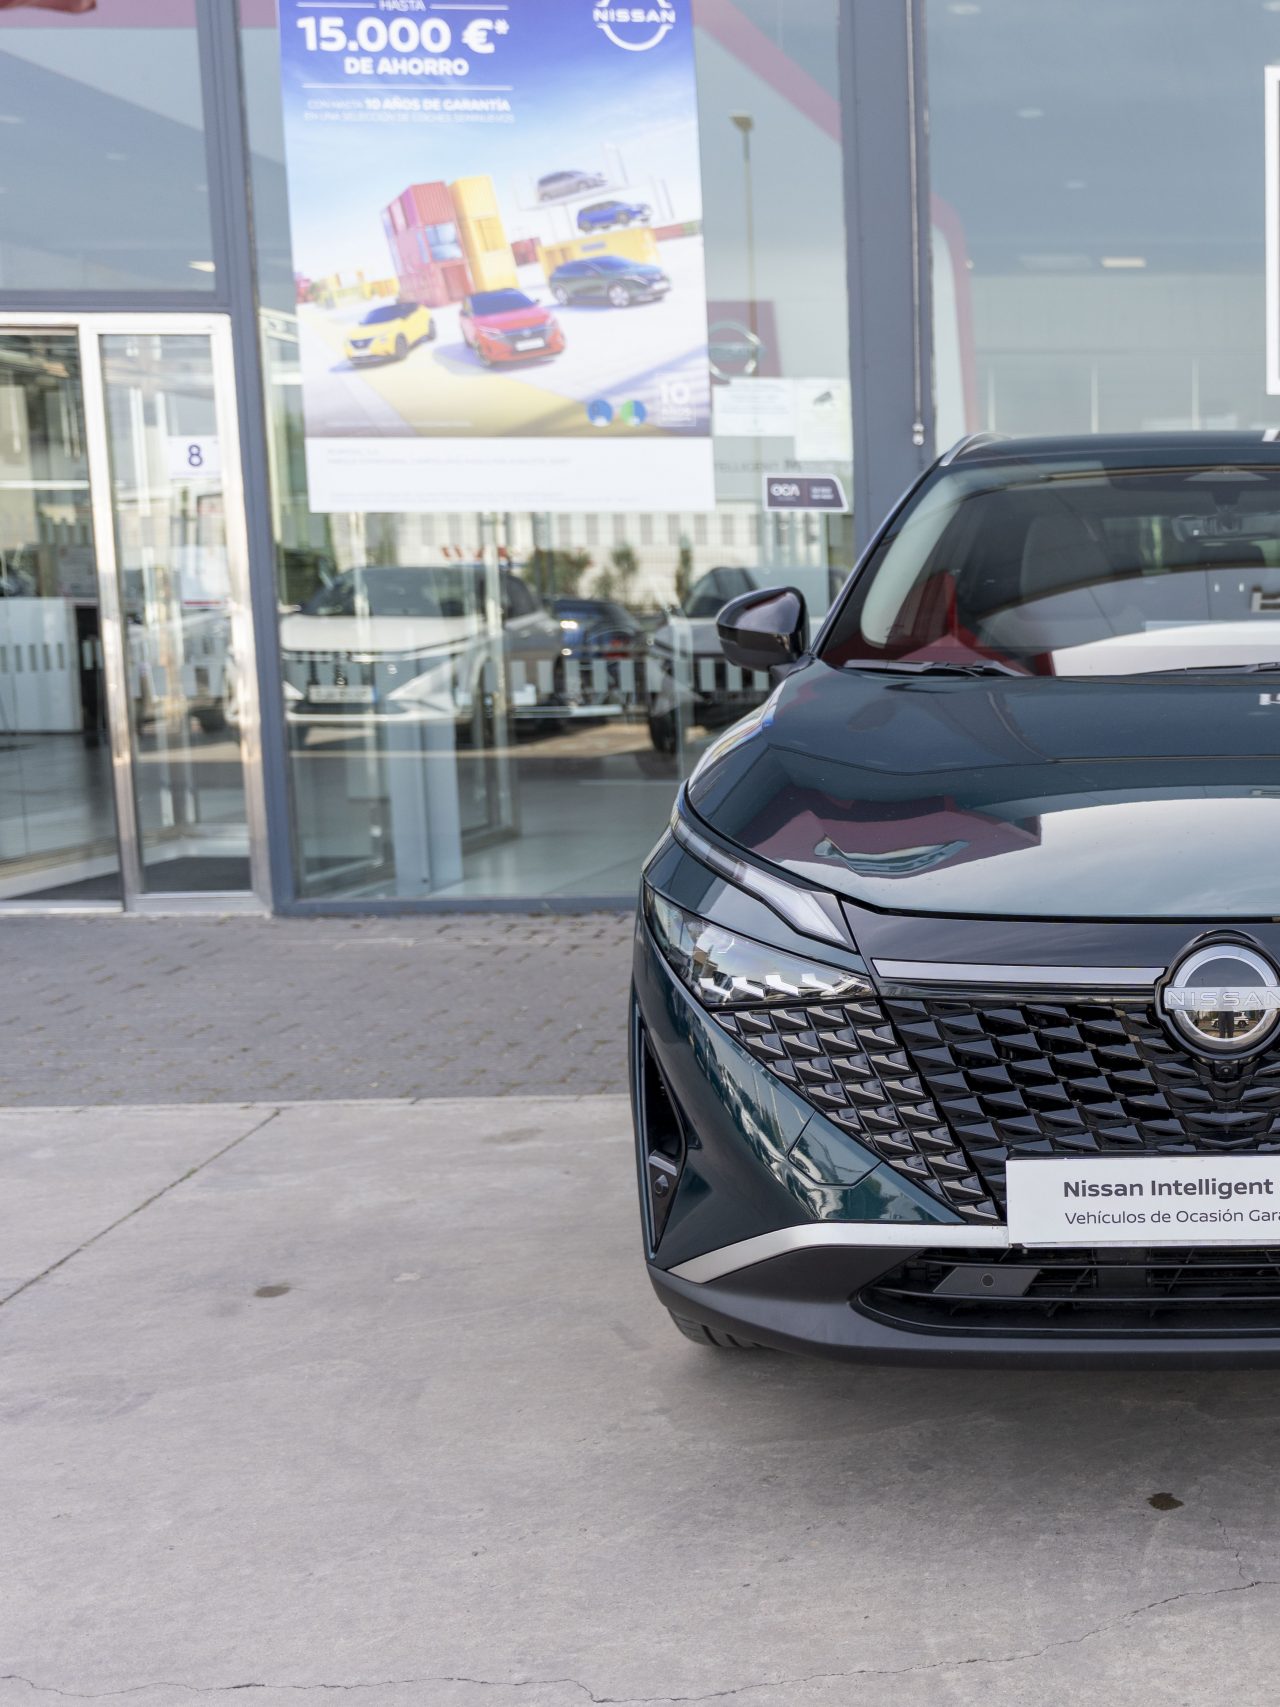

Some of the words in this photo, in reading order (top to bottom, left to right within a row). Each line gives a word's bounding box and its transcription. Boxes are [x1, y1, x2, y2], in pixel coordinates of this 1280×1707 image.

[379, 0, 426, 12] HASTA
[593, 8, 676, 24] NISSAN
[296, 17, 452, 54] 15.000
[344, 57, 374, 75] DE
[377, 57, 469, 76] AHORRO
[188, 444, 204, 467] 8
[1063, 1179, 1144, 1198] Nissan
[1151, 1177, 1274, 1200] Intelligent
[1064, 1210, 1146, 1225] Vehículos
[1150, 1210, 1171, 1224] de
[1175, 1208, 1244, 1223] Ocasión
